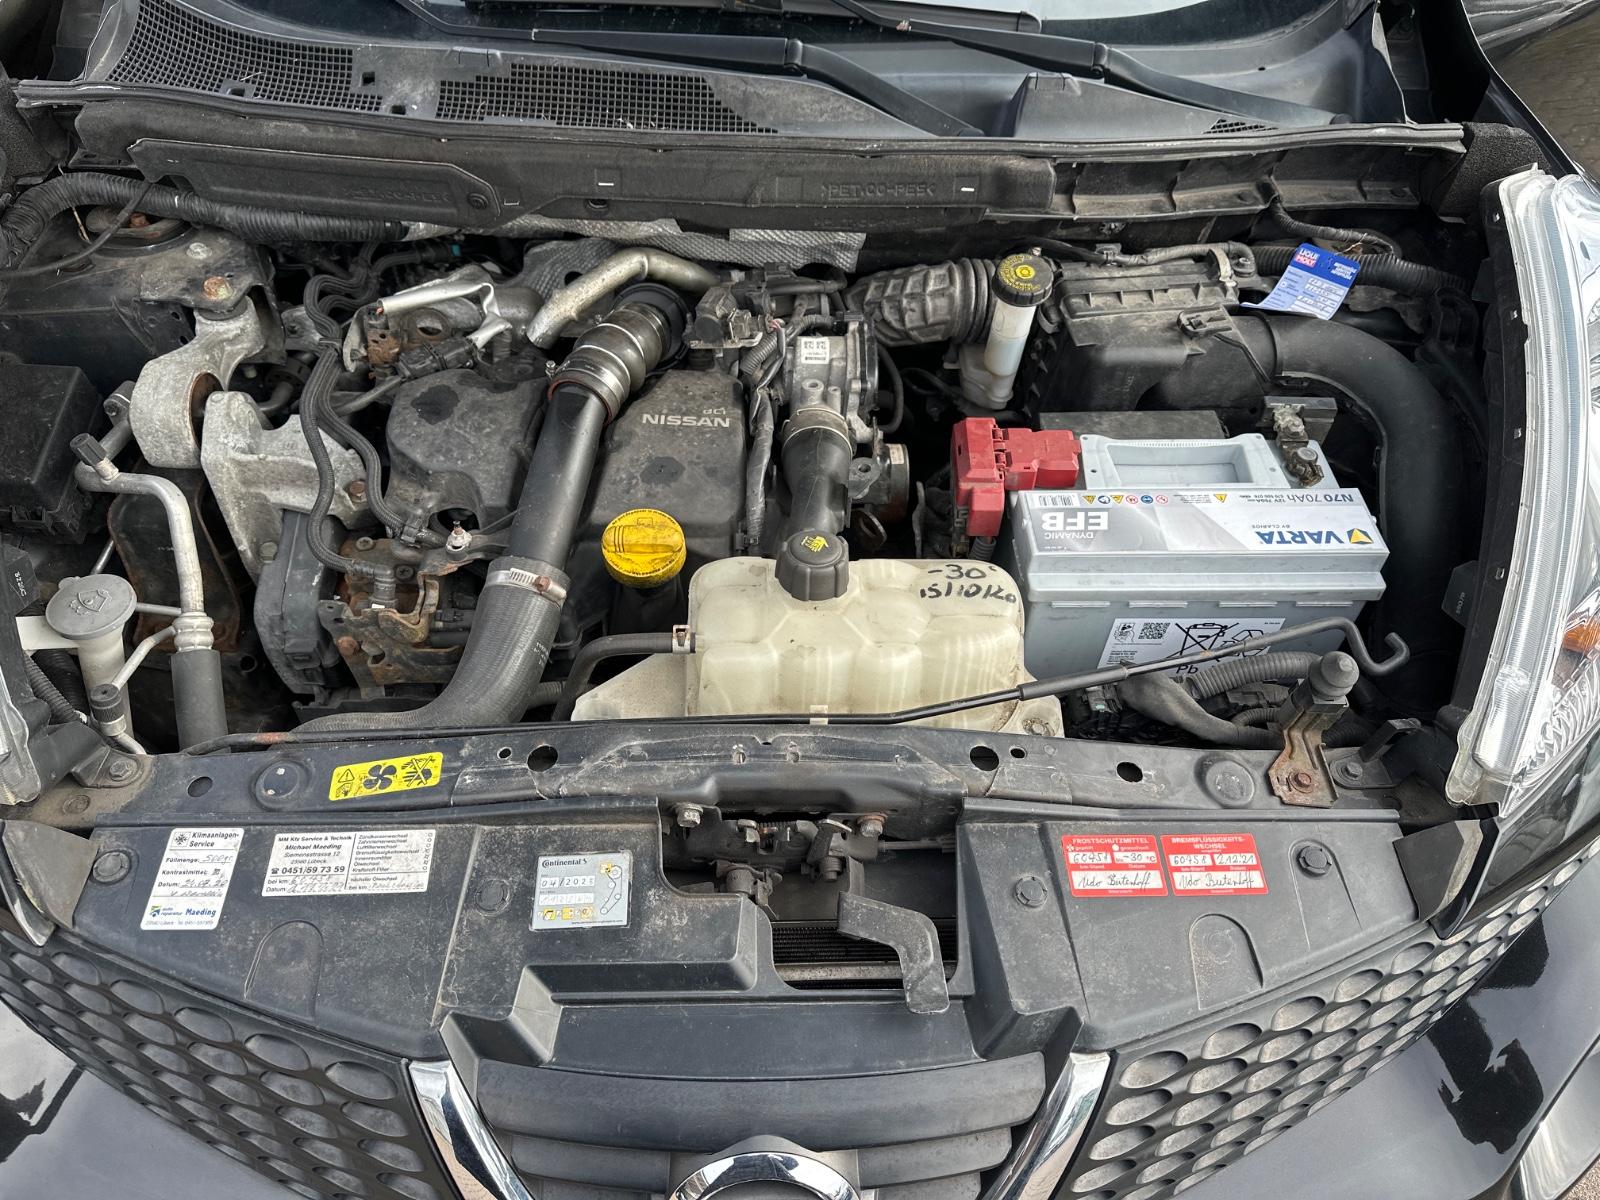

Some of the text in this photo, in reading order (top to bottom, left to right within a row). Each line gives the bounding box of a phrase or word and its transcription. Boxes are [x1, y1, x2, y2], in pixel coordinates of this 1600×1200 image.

[642, 413, 730, 428] NISSAN
[1287, 493, 1323, 503] 70Ah
[1323, 494, 1354, 503] N70
[1041, 511, 1109, 531] EFB
[1044, 531, 1094, 540] DYNAMIC
[1255, 530, 1345, 545] VARTA
[1176, 665, 1199, 674] Pb
[191, 831, 239, 840] Klimaanlagen-
[541, 858, 581, 868] Continental
[281, 866, 317, 874] 0451/59
[185, 908, 216, 917] Maeding
